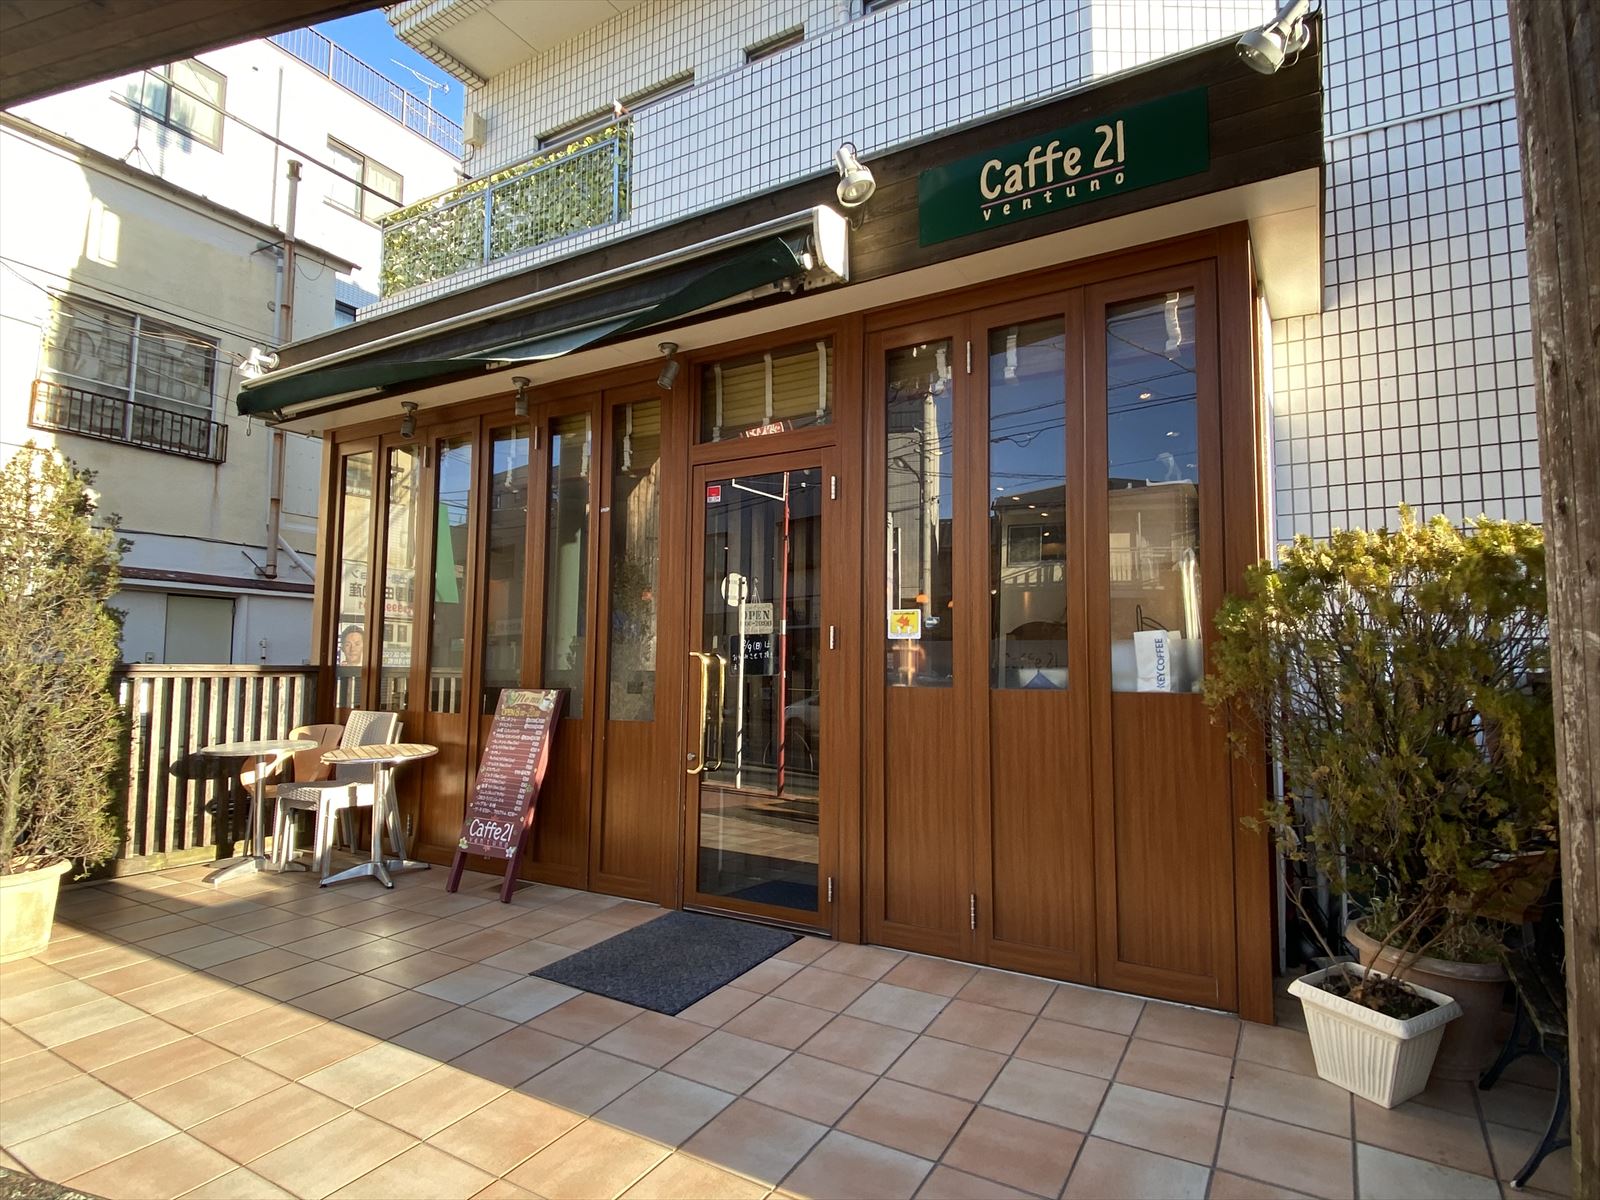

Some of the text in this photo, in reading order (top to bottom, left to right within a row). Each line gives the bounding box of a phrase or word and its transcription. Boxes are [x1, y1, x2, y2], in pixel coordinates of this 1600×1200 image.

[980, 119, 1126, 200] Caffe 21
[983, 171, 1125, 221] ventuno
[1154, 638, 1166, 689] KEY COFFEE
